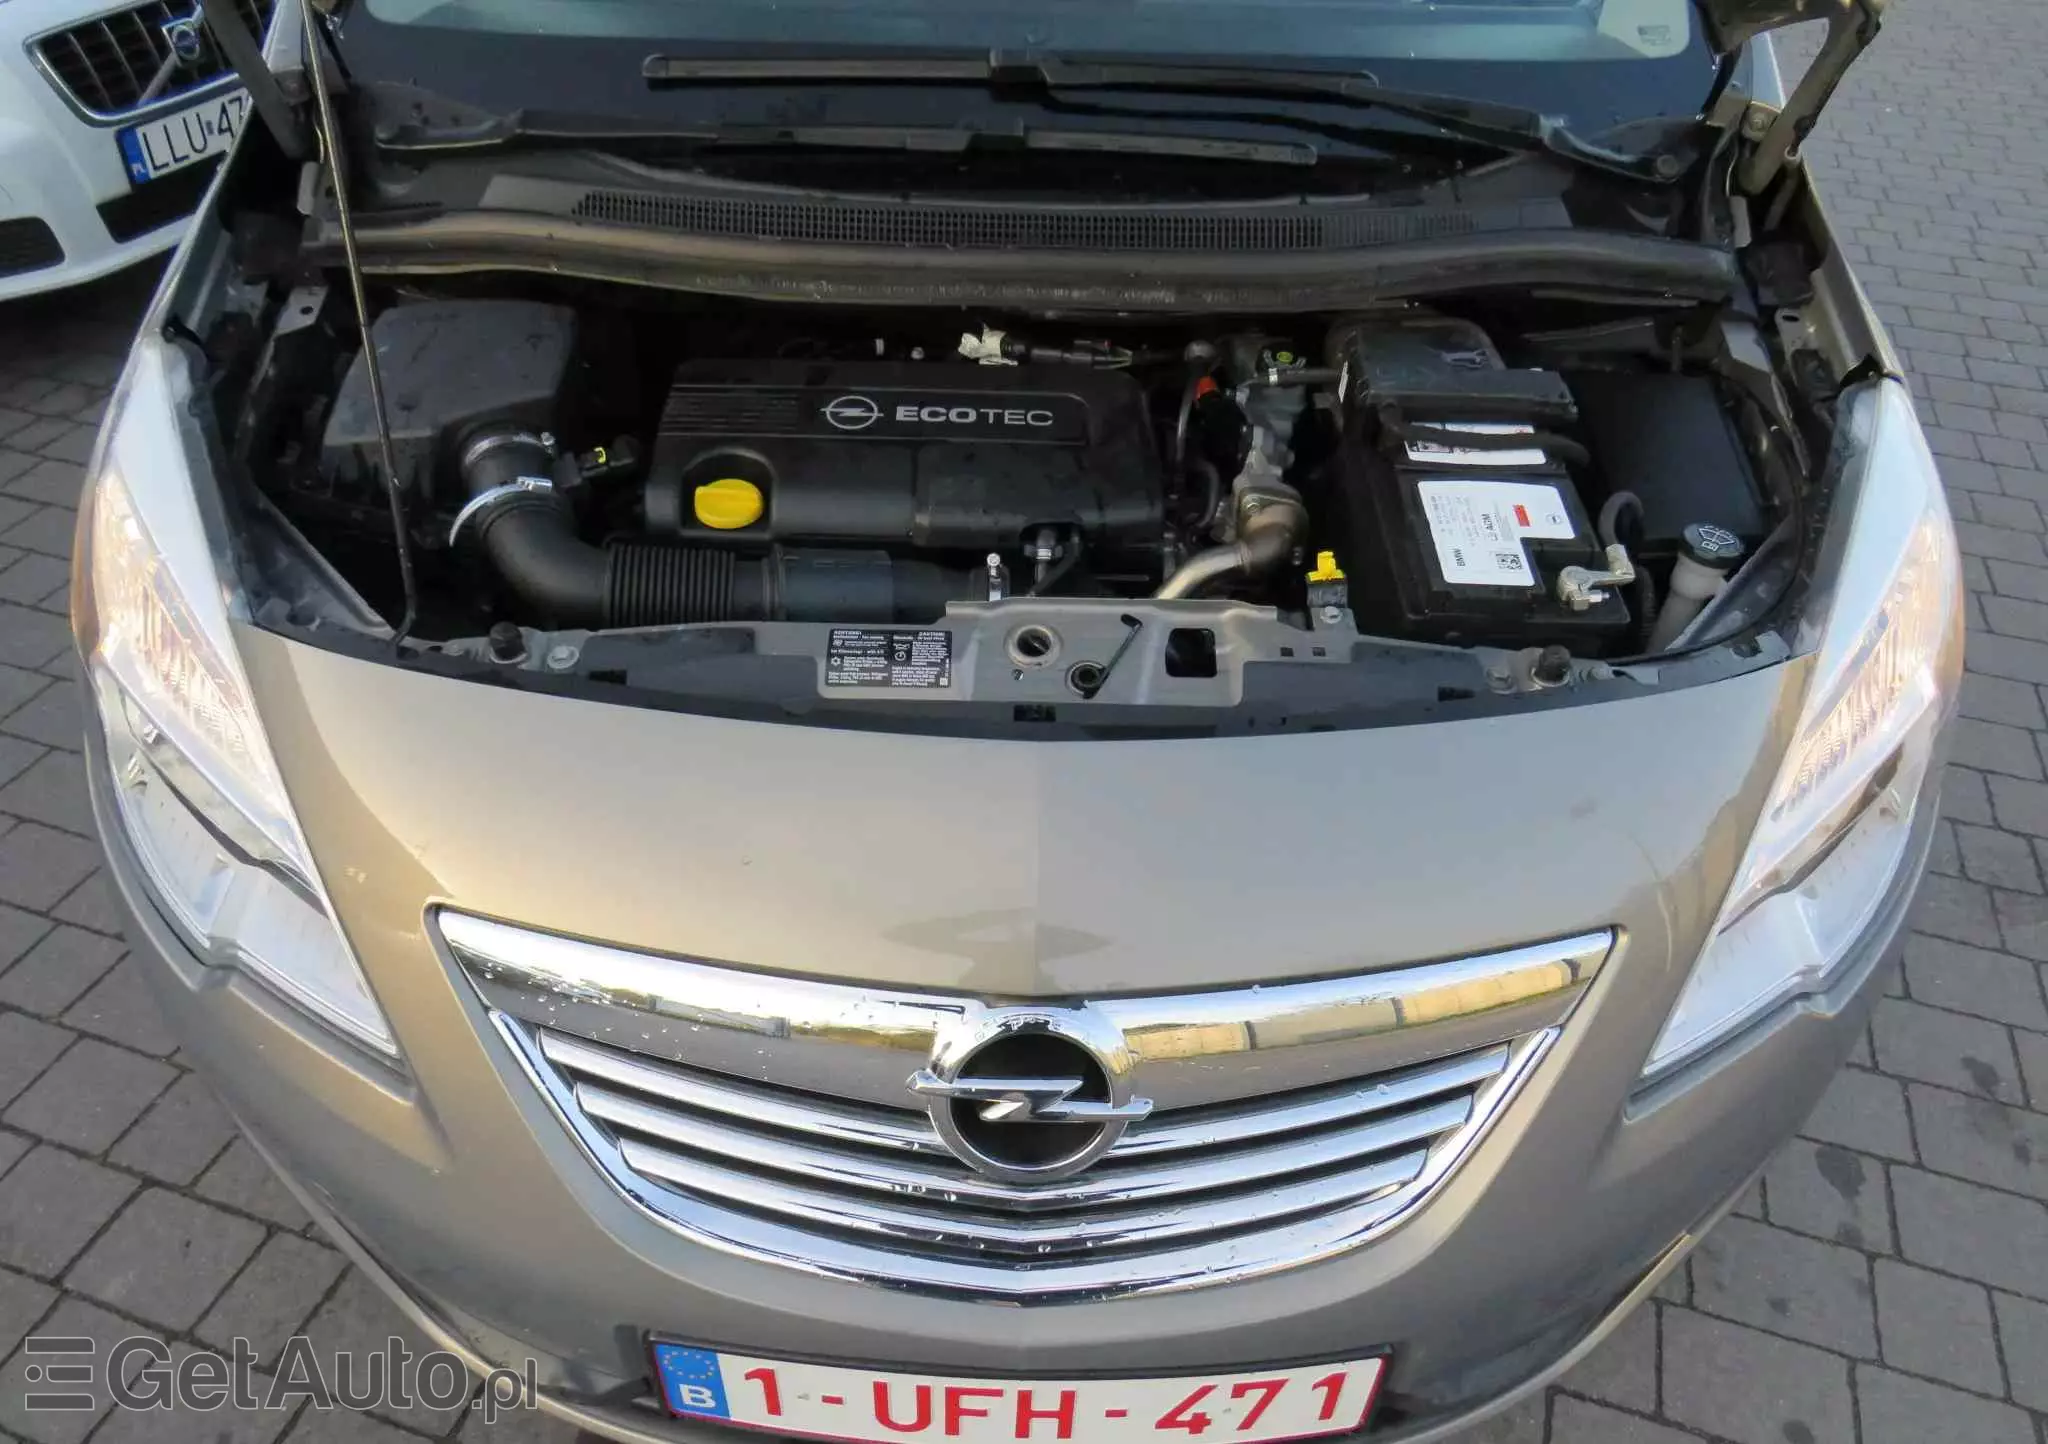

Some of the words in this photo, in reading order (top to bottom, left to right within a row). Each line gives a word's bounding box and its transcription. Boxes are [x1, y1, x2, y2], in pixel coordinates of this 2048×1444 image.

[142, 112, 208, 171] LLU
[895, 406, 1054, 427] ECOTEC
[1453, 548, 1466, 567] BMW
[680, 1383, 716, 1408] B
[744, 1367, 1348, 1438] 1-UFH-471
